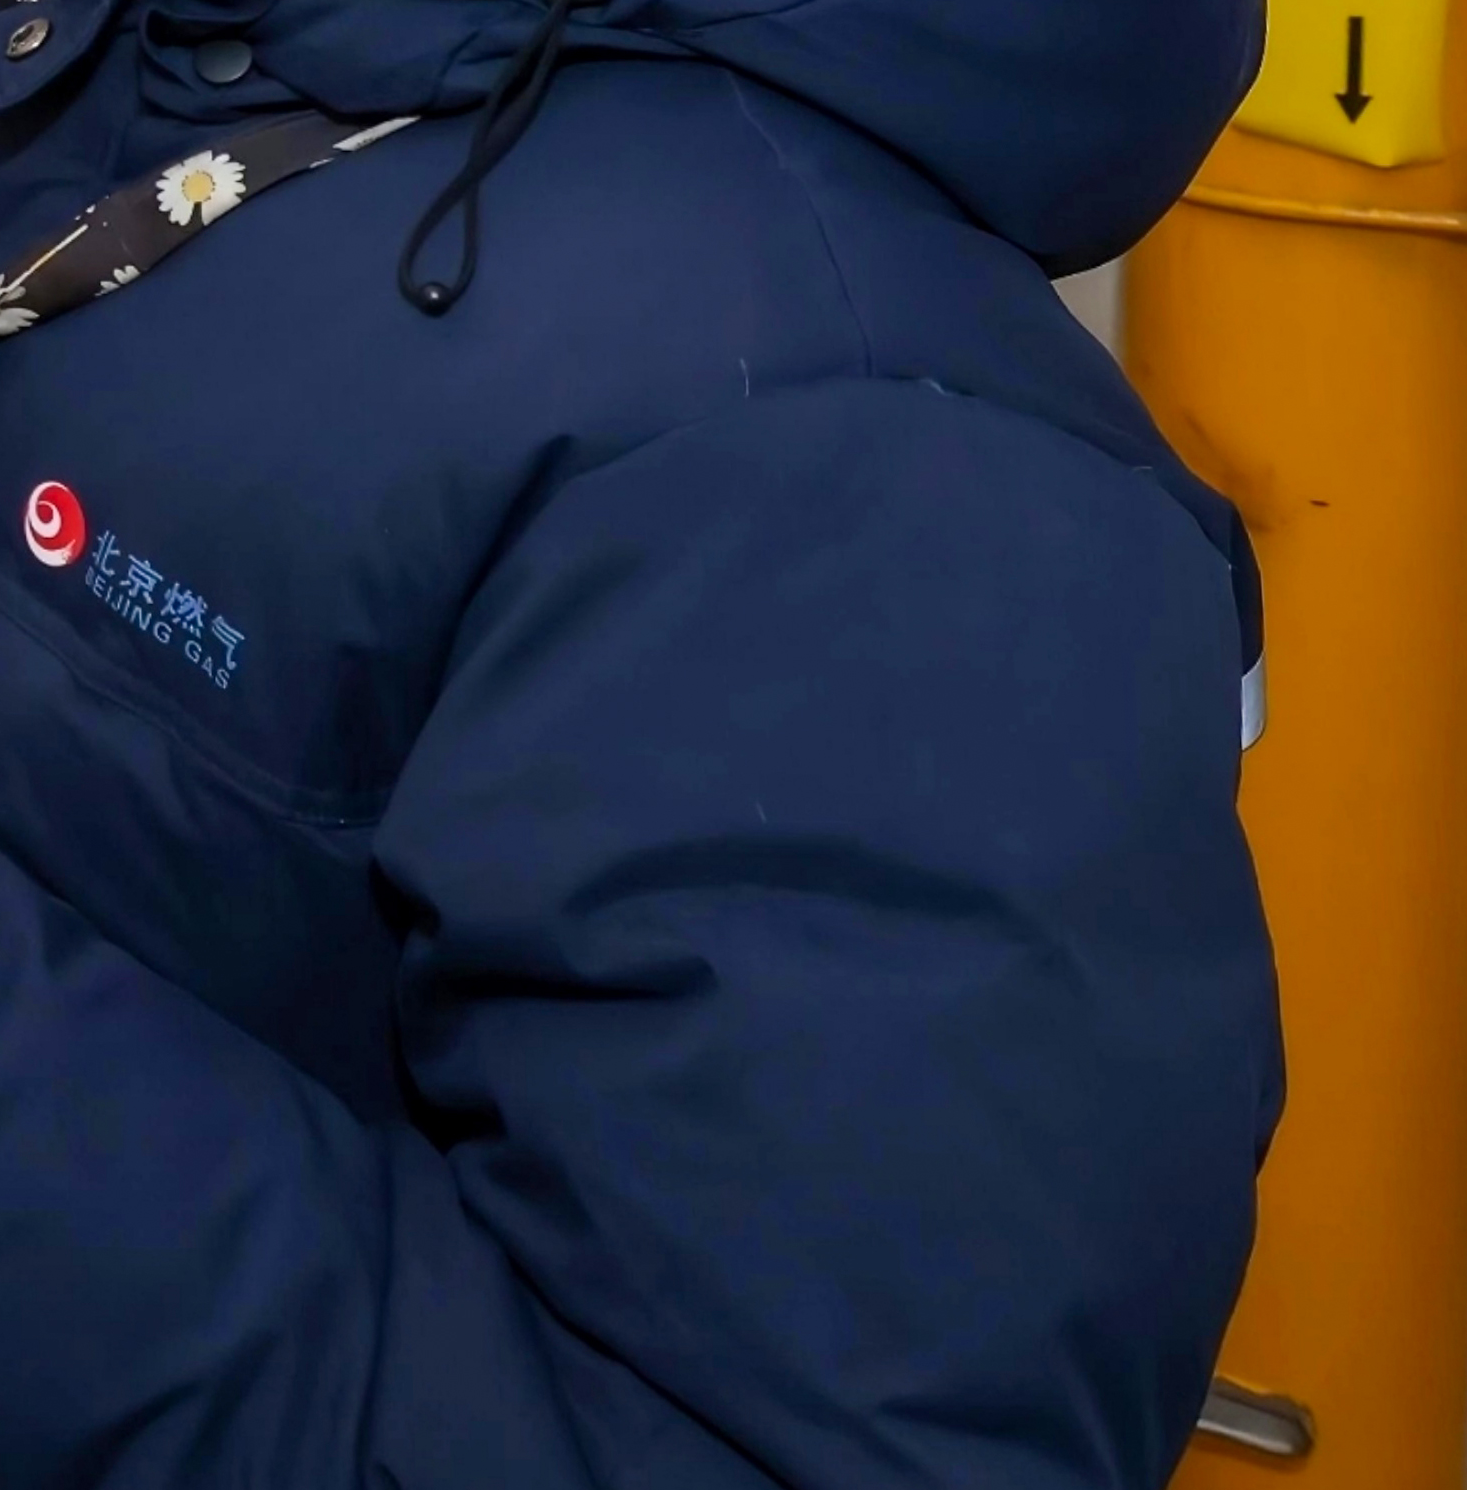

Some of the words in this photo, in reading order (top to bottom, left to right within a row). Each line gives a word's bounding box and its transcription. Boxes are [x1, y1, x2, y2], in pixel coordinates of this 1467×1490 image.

[85, 566, 173, 644] BEIJING
[184, 639, 230, 690] GAS
[92, 530, 245, 670] 北京燃气
